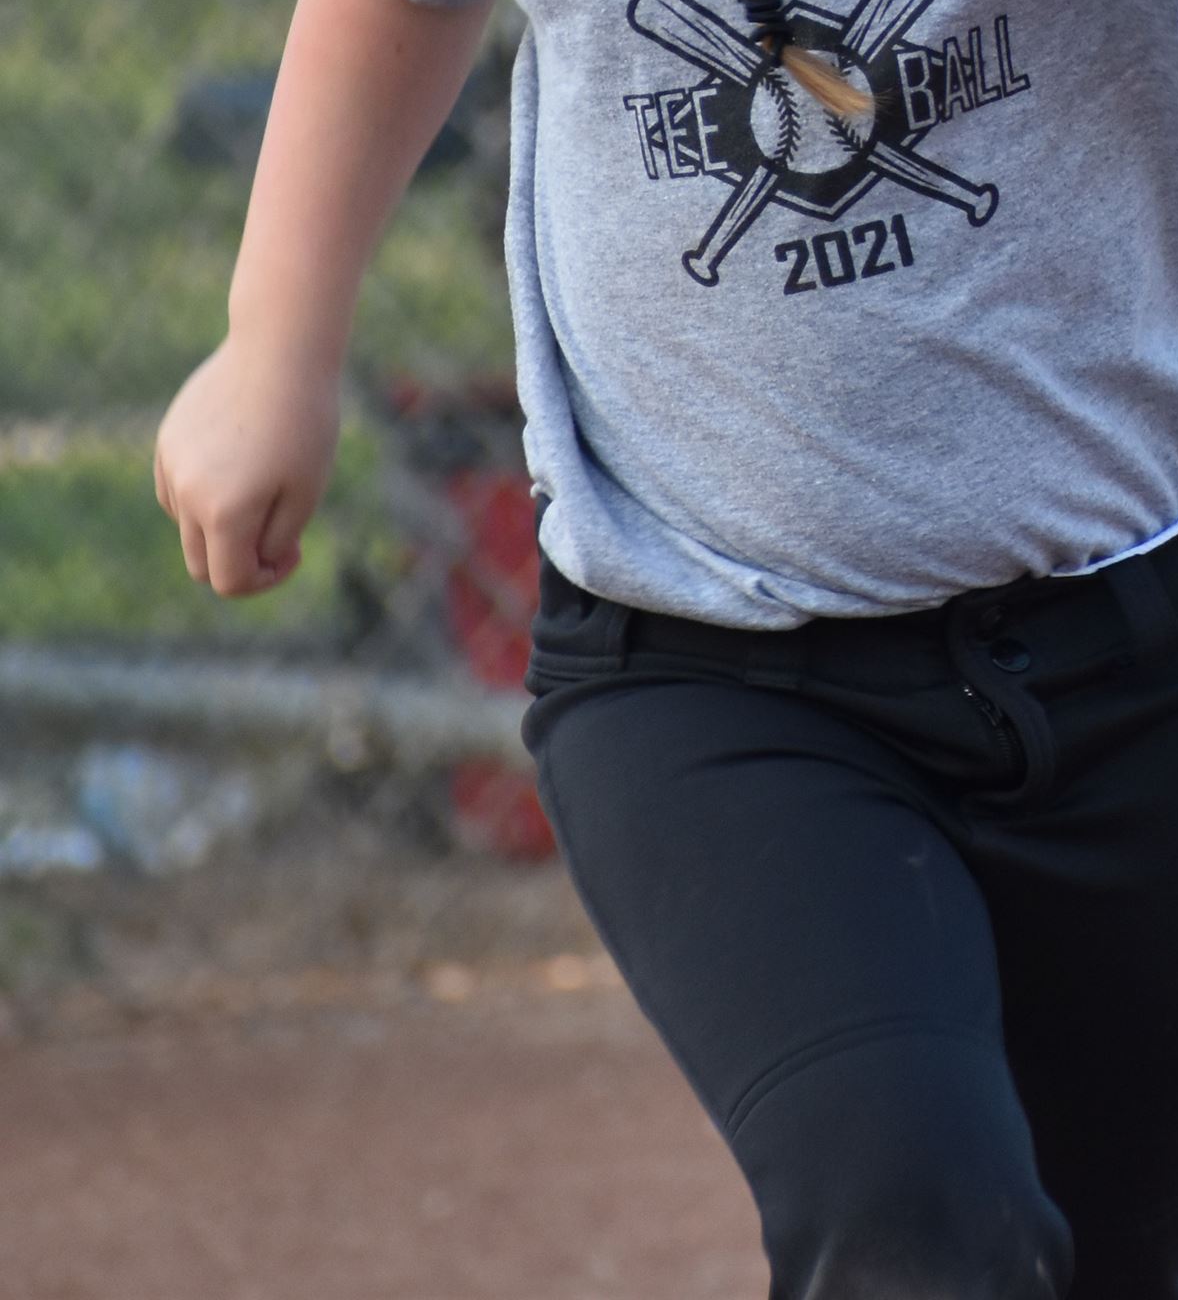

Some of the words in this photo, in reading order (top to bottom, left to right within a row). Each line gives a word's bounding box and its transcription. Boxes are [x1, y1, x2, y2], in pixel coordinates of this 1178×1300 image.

[624, 83, 728, 180] TEE
[896, 15, 1031, 131] BALL
[775, 213, 914, 295] 2021
